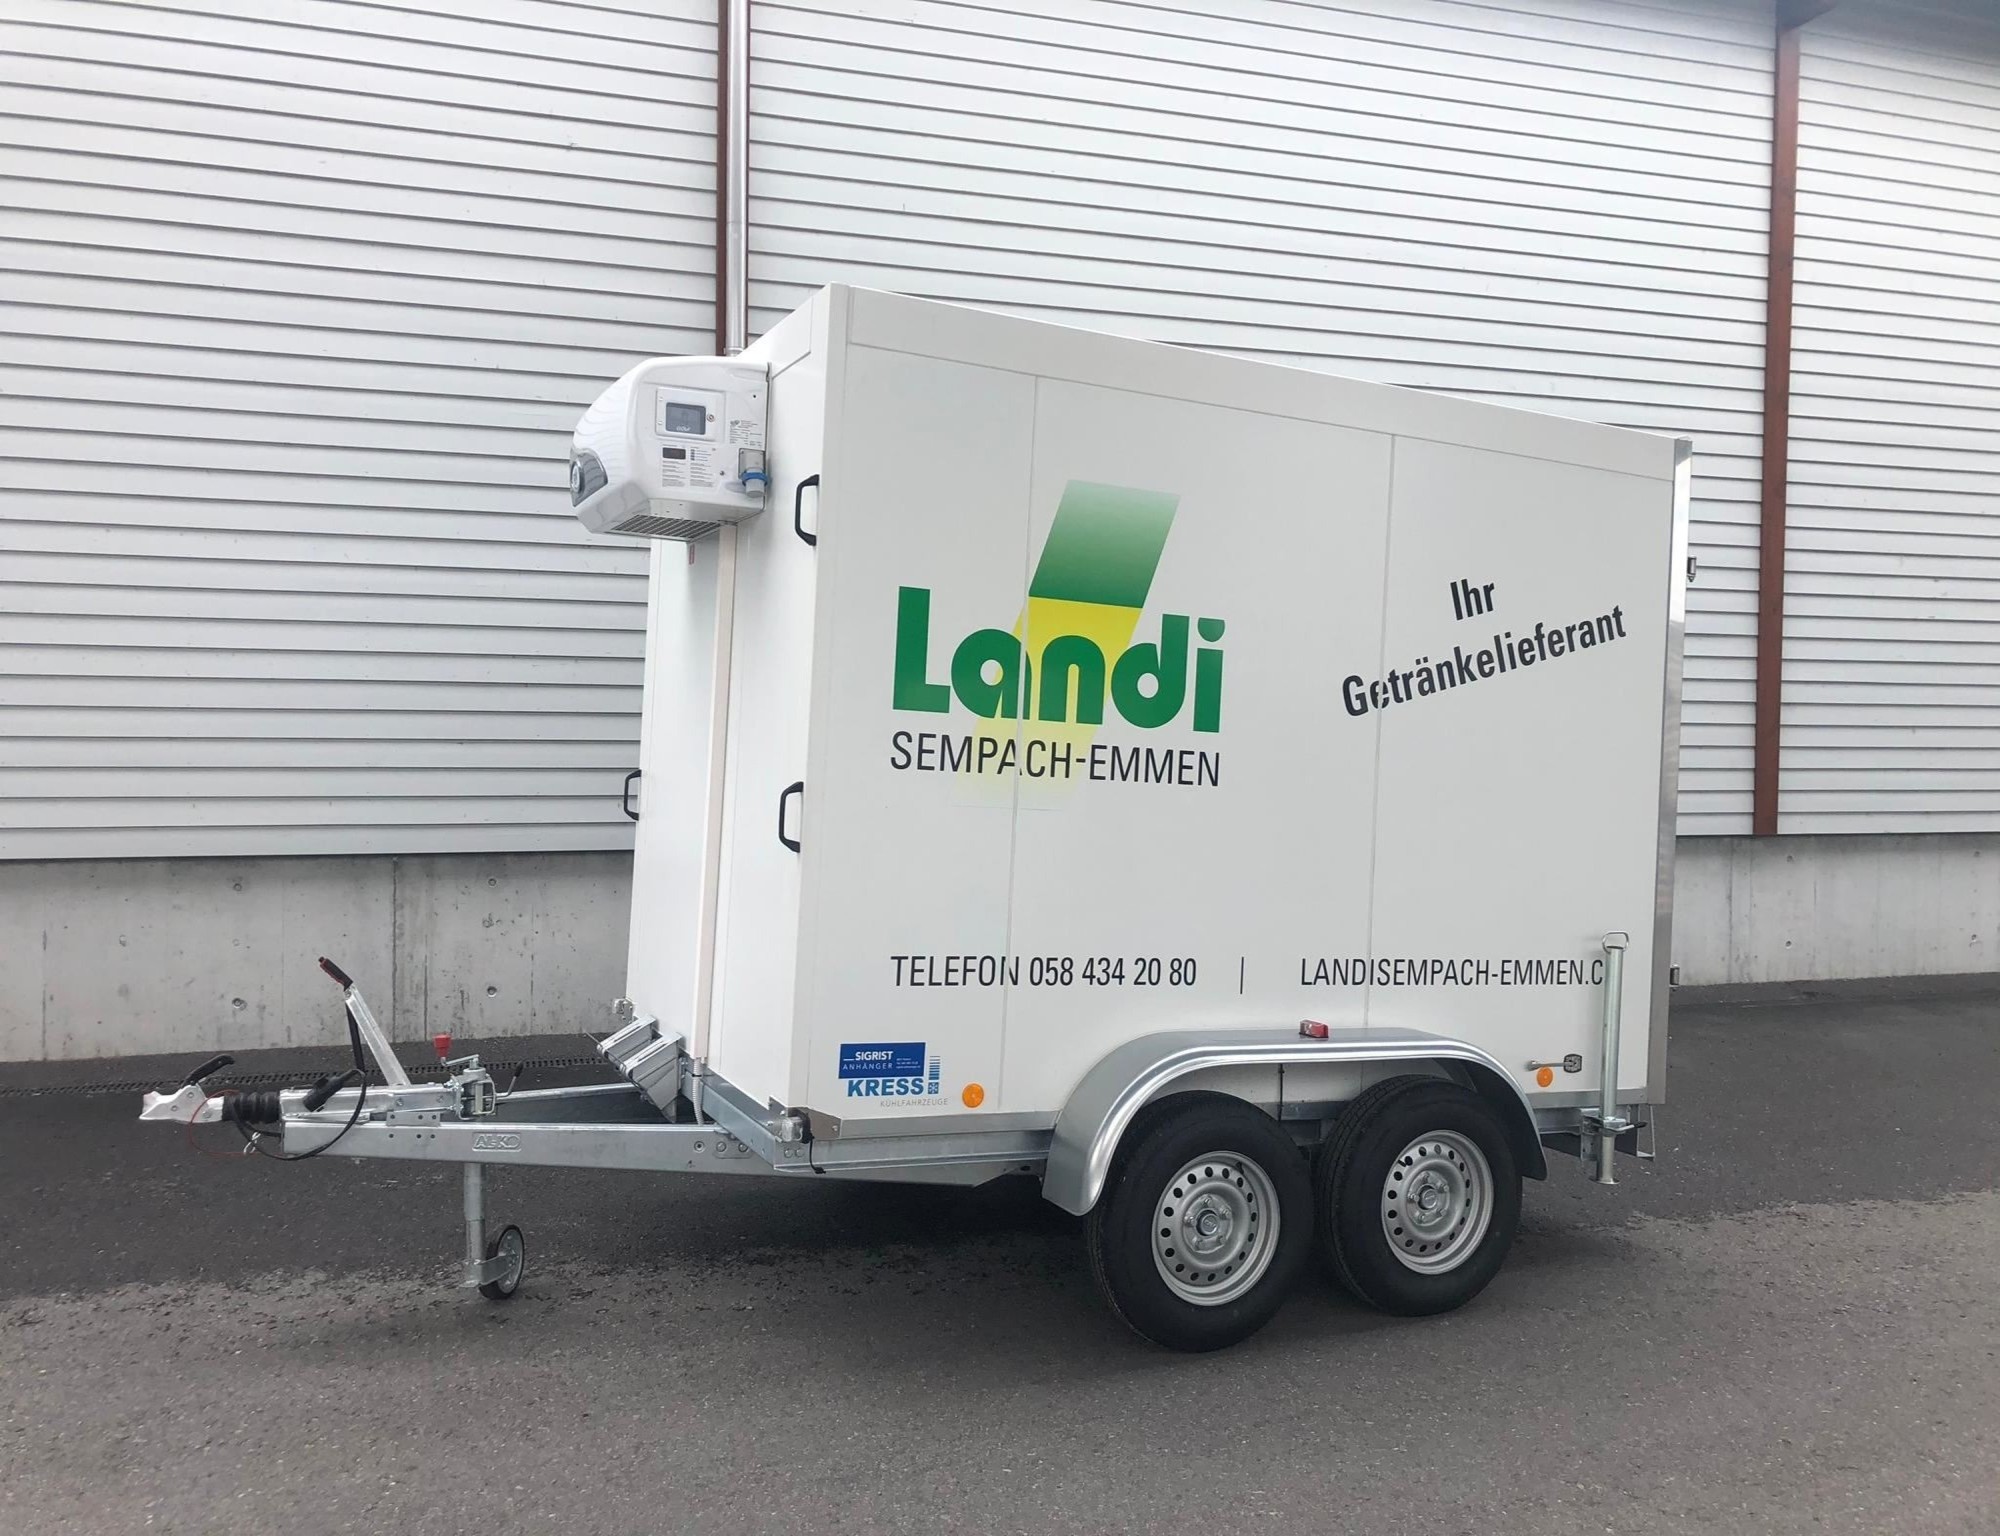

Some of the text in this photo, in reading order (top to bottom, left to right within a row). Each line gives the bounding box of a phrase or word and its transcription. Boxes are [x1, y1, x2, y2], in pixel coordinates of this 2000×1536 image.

[1450, 578, 1495, 621] Ihr
[893, 585, 1226, 733] Landi
[1342, 605, 1627, 717] Getränkelieferant
[890, 731, 1220, 787] SEMPACH-EMMEN
[890, 955, 1197, 987] TELEFON 058 434 20 80
[1301, 957, 1604, 987] LANDISEMPACH-EMMEN.C
[842, 1062, 893, 1070] ANHÄNGER
[855, 1051, 893, 1061] SIGRIST
[848, 1078, 924, 1096] KRESS
